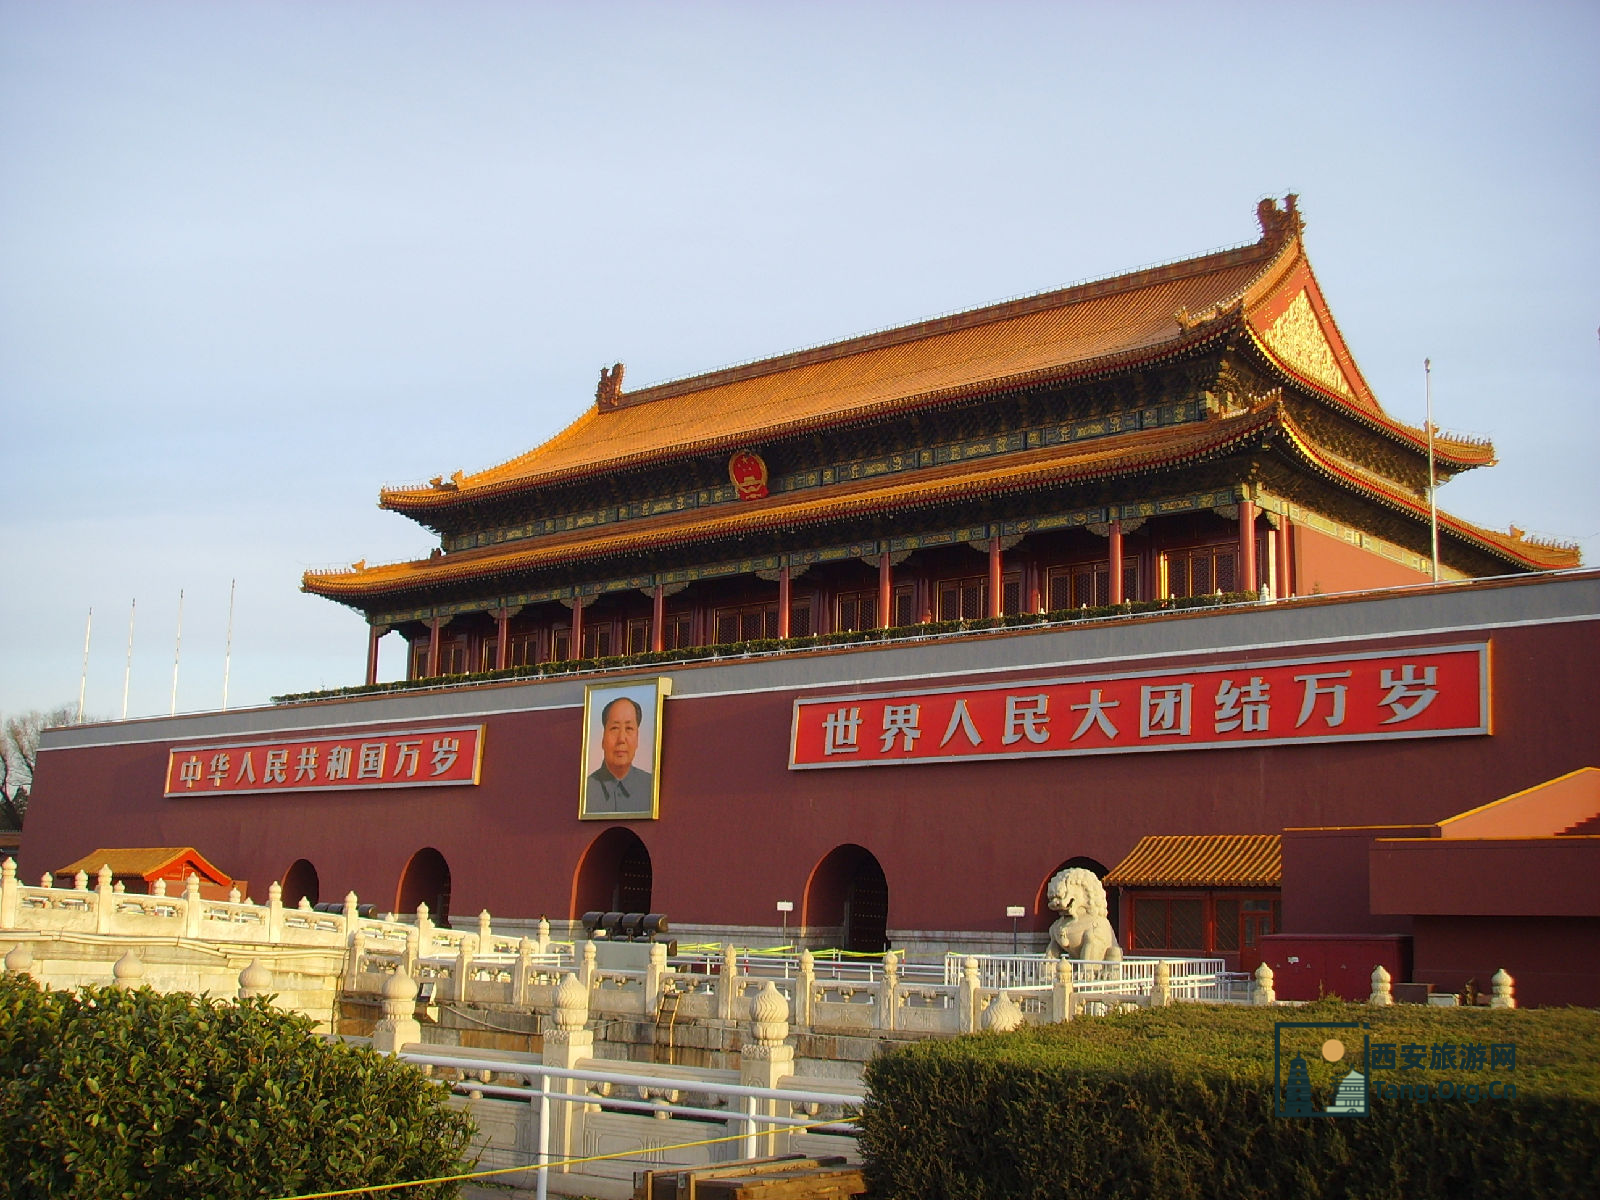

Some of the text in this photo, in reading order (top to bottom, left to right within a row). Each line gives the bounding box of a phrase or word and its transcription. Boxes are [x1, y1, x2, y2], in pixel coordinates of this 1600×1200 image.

[821, 664, 1440, 755] 世界人民大团结万岁
[179, 736, 461, 788] 中华人民共和国万岁
